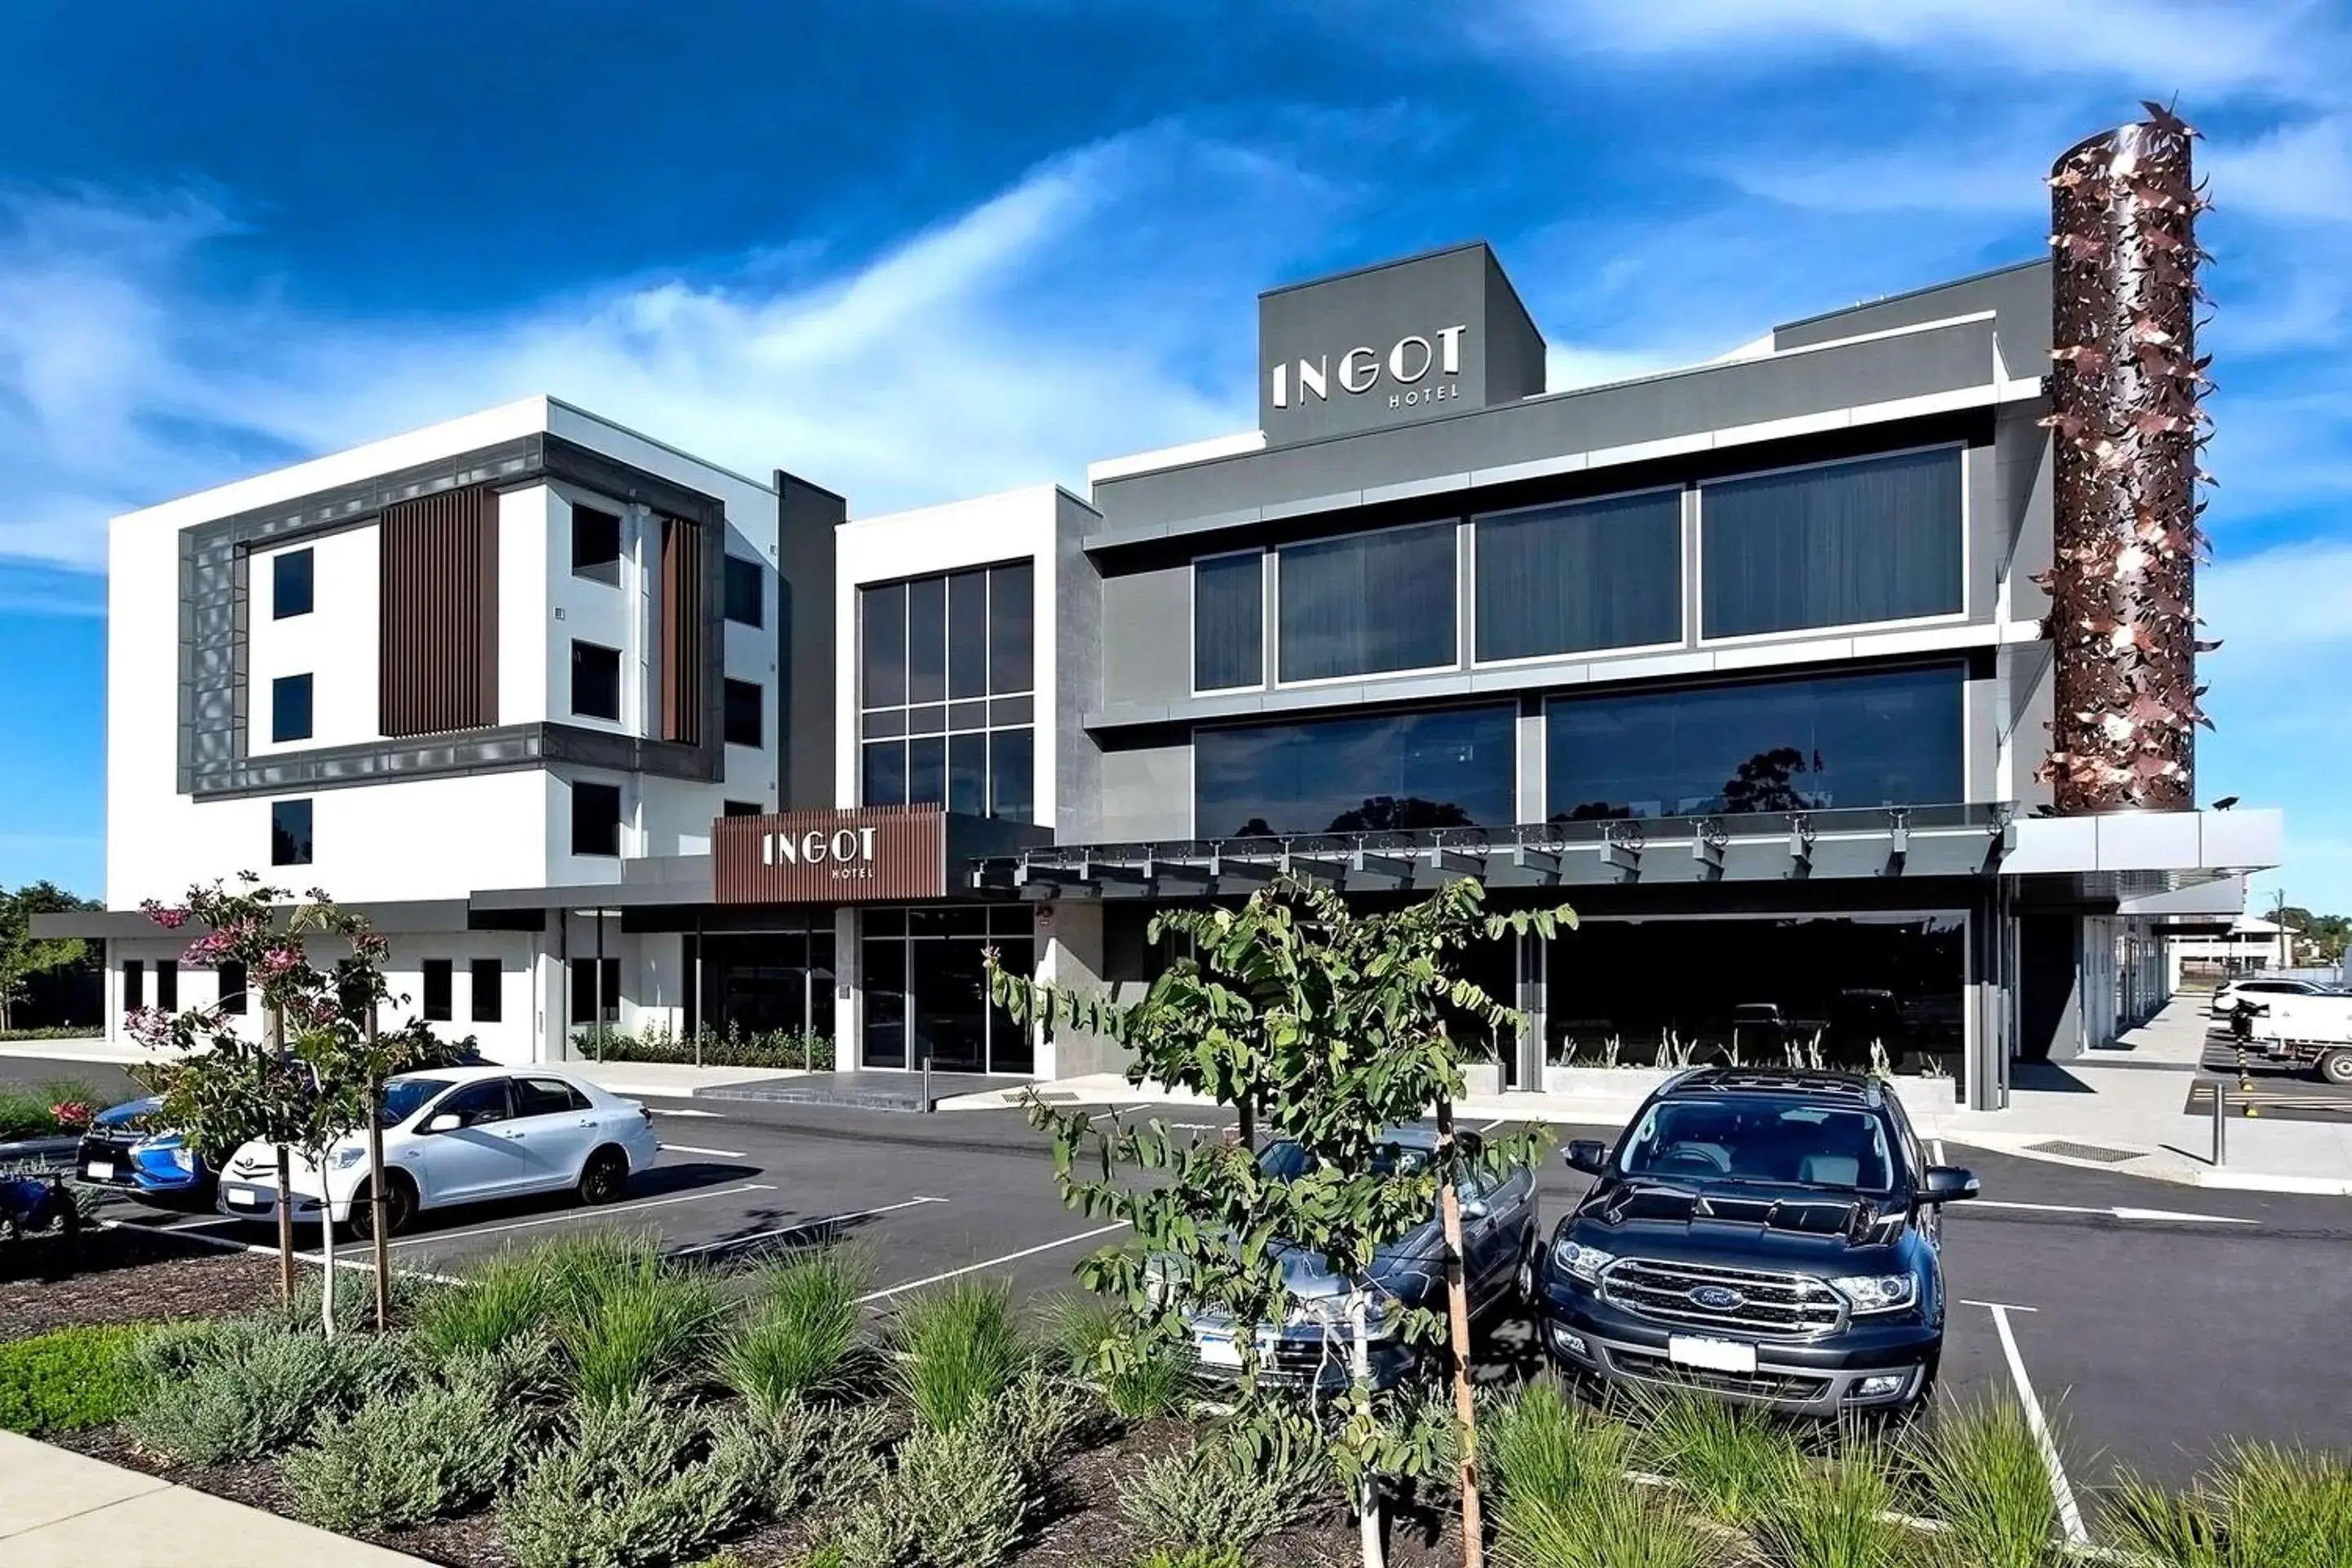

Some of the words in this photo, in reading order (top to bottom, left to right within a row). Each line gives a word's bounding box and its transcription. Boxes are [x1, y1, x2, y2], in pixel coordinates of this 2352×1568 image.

[1272, 324, 1466, 408] INGOT
[1389, 383, 1459, 408] HOTEL
[763, 827, 876, 866] INGOT
[831, 867, 874, 880] HOTEL
